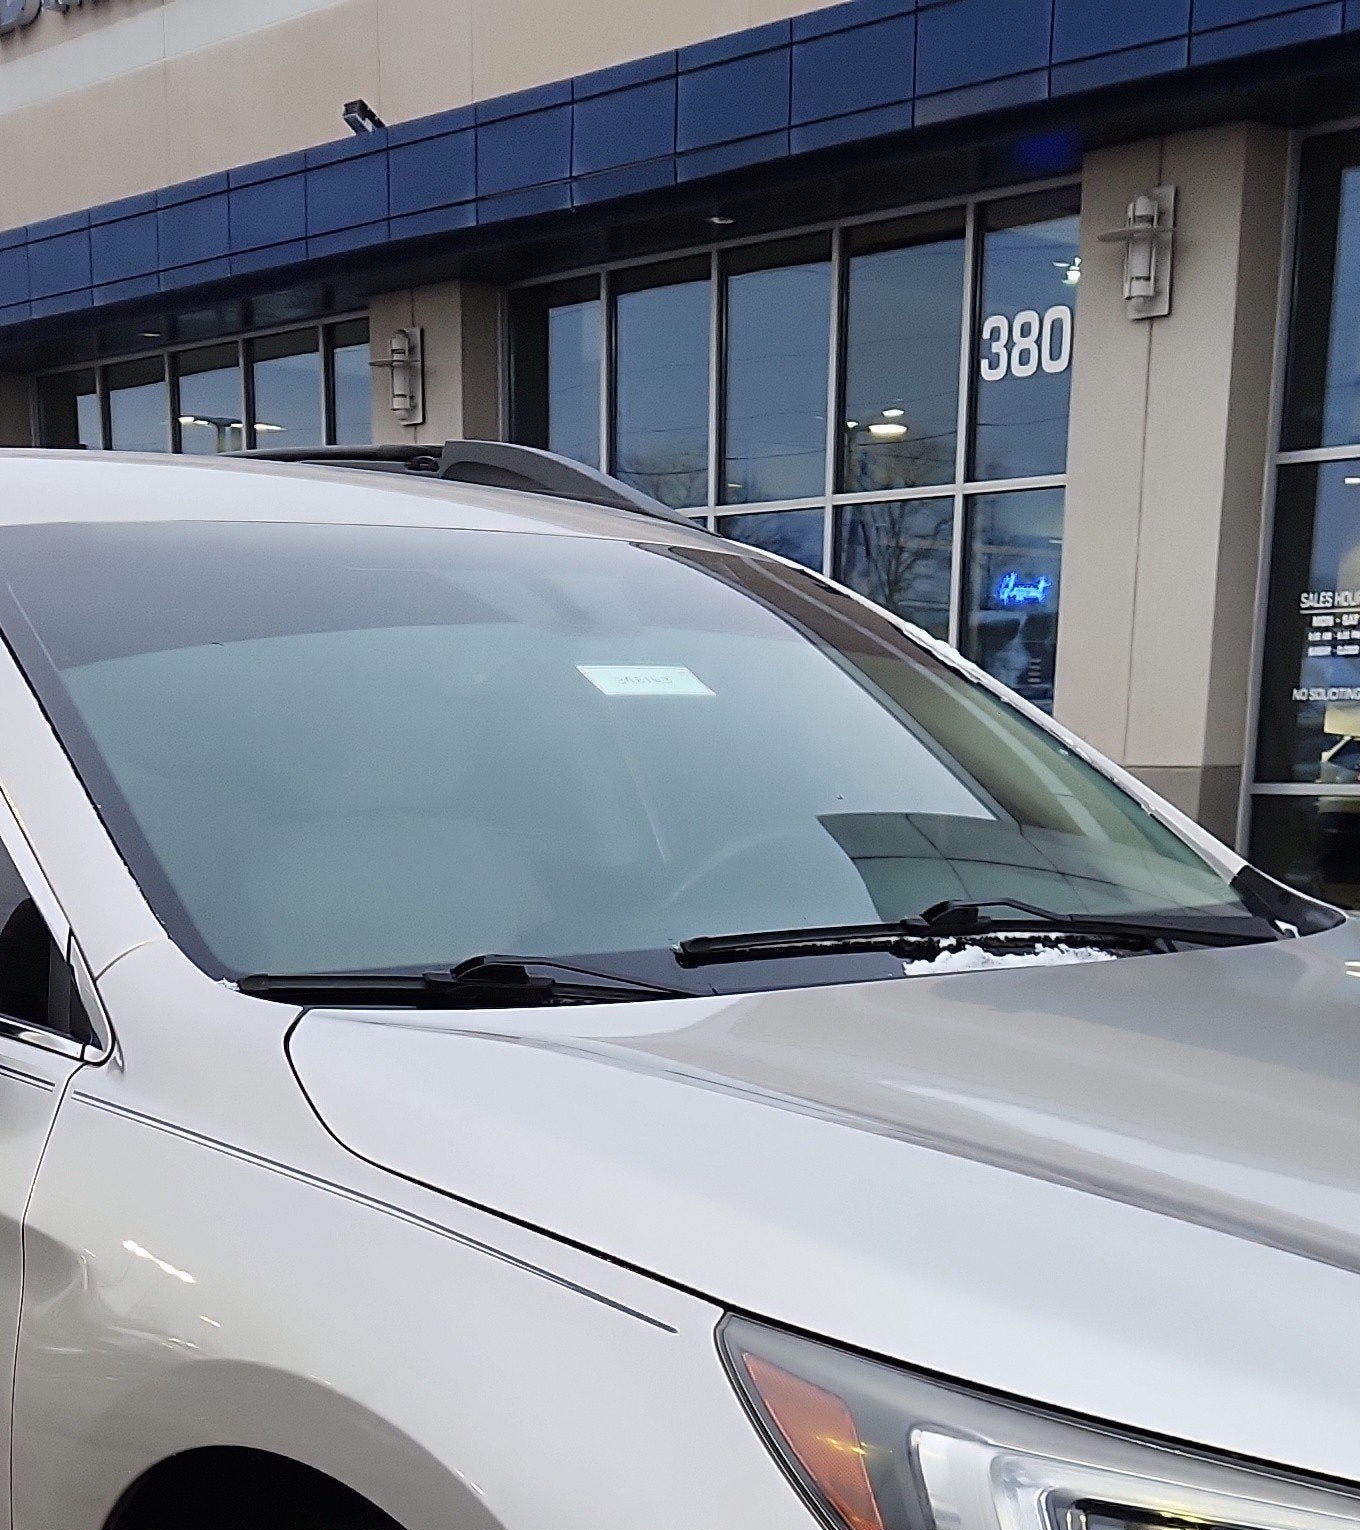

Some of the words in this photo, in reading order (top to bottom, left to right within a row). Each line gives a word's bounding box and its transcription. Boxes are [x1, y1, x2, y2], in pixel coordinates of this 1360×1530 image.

[981, 305, 1072, 381] 380
[1300, 591, 1333, 608] SALES
[1292, 688, 1308, 701] NO
